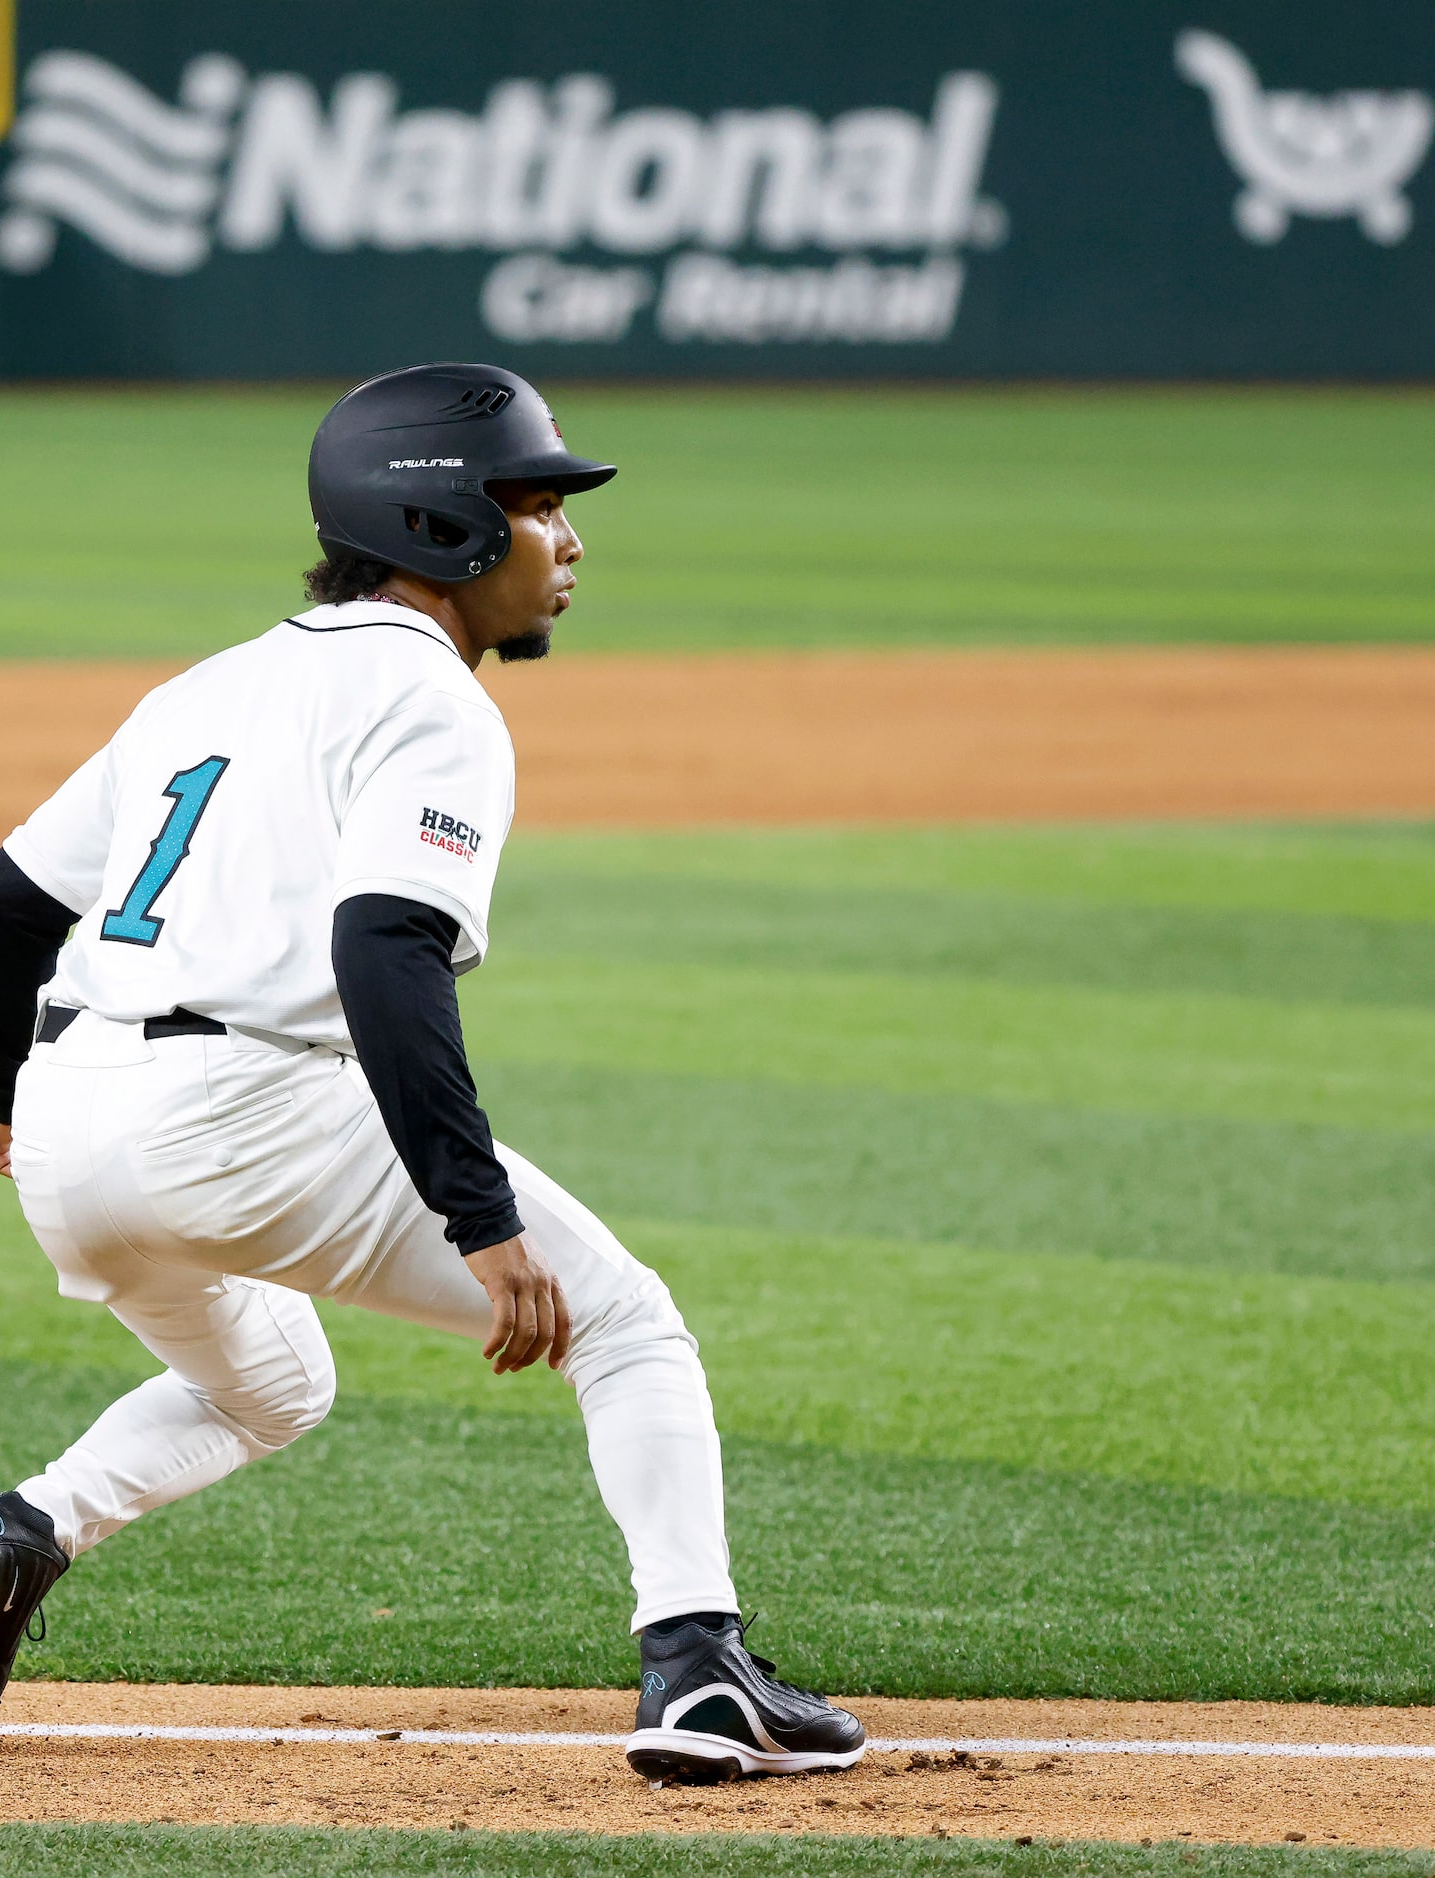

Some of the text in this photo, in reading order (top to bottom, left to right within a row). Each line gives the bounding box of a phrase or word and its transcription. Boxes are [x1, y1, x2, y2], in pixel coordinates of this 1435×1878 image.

[220, 70, 999, 252] National
[480, 253, 965, 343] Car Rental
[388, 458, 464, 470] RAWLINGS
[99, 754, 232, 948] 1
[419, 806, 482, 853] HBCU
[420, 830, 474, 864] CLASSIC
